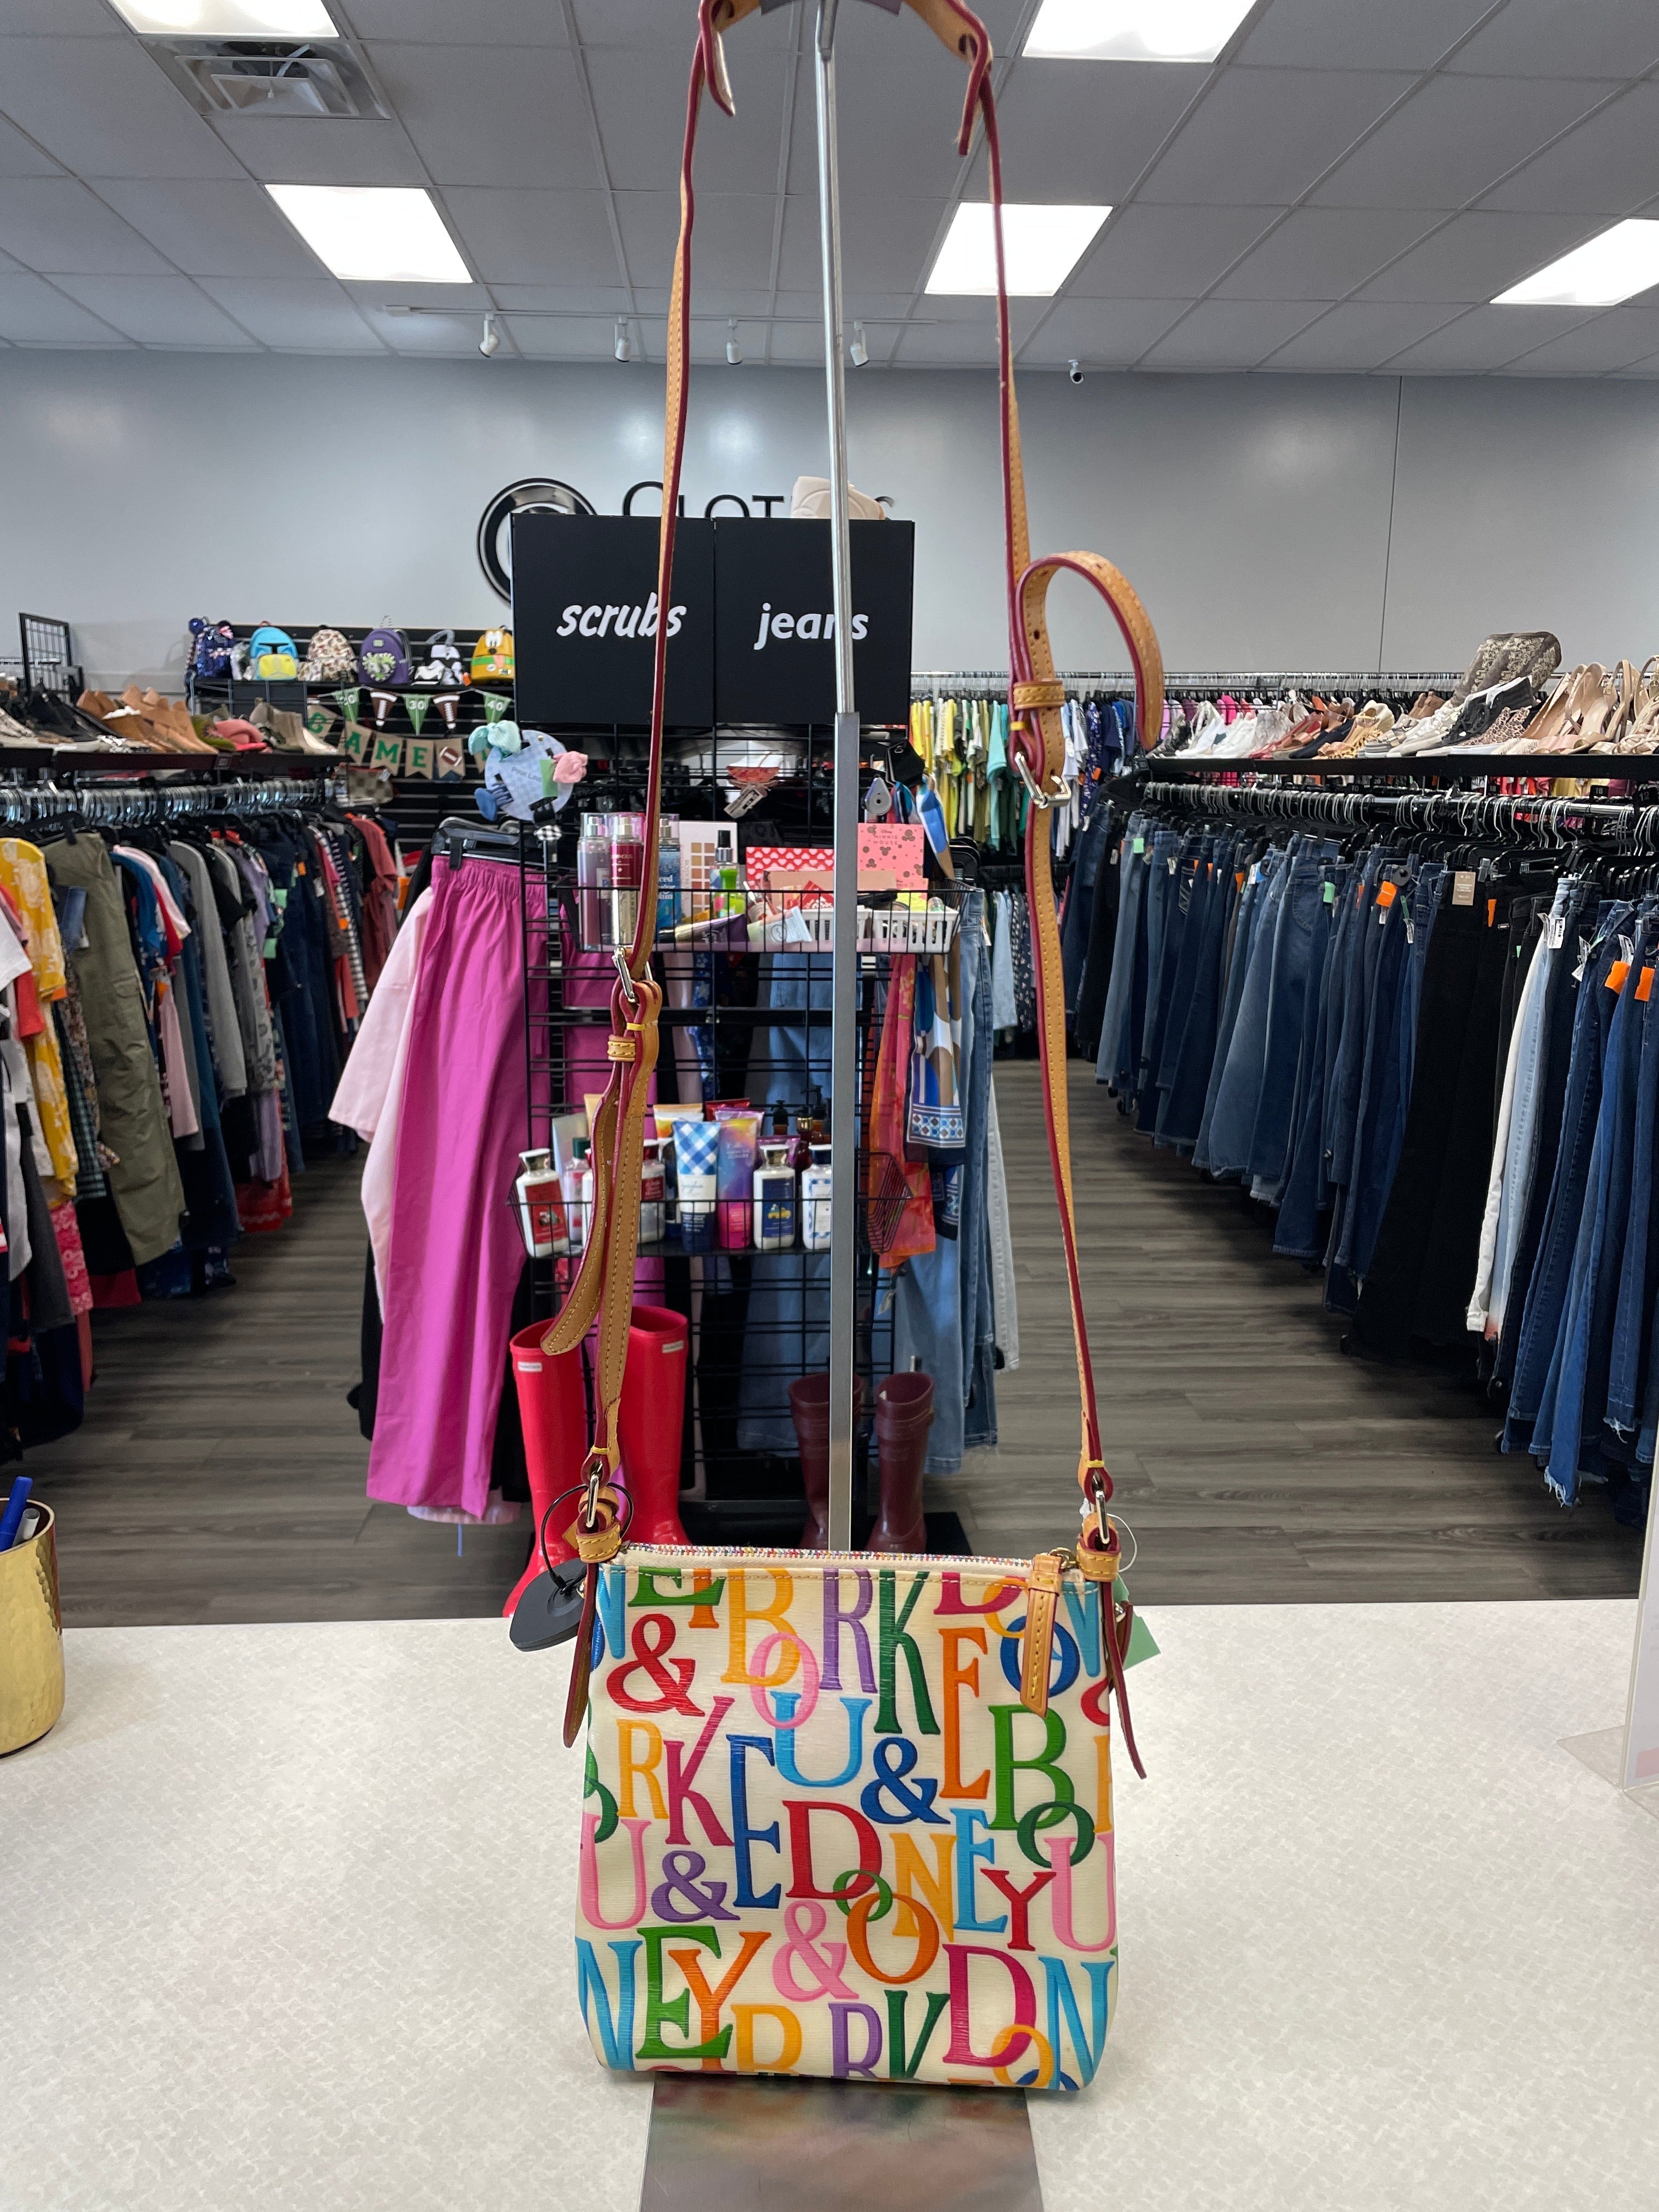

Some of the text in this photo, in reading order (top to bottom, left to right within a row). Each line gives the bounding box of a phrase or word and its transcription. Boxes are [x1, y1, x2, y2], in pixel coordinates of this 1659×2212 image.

[556, 591, 687, 638] scrubs
[409, 701, 425, 710] 30
[487, 700, 504, 712] 40
